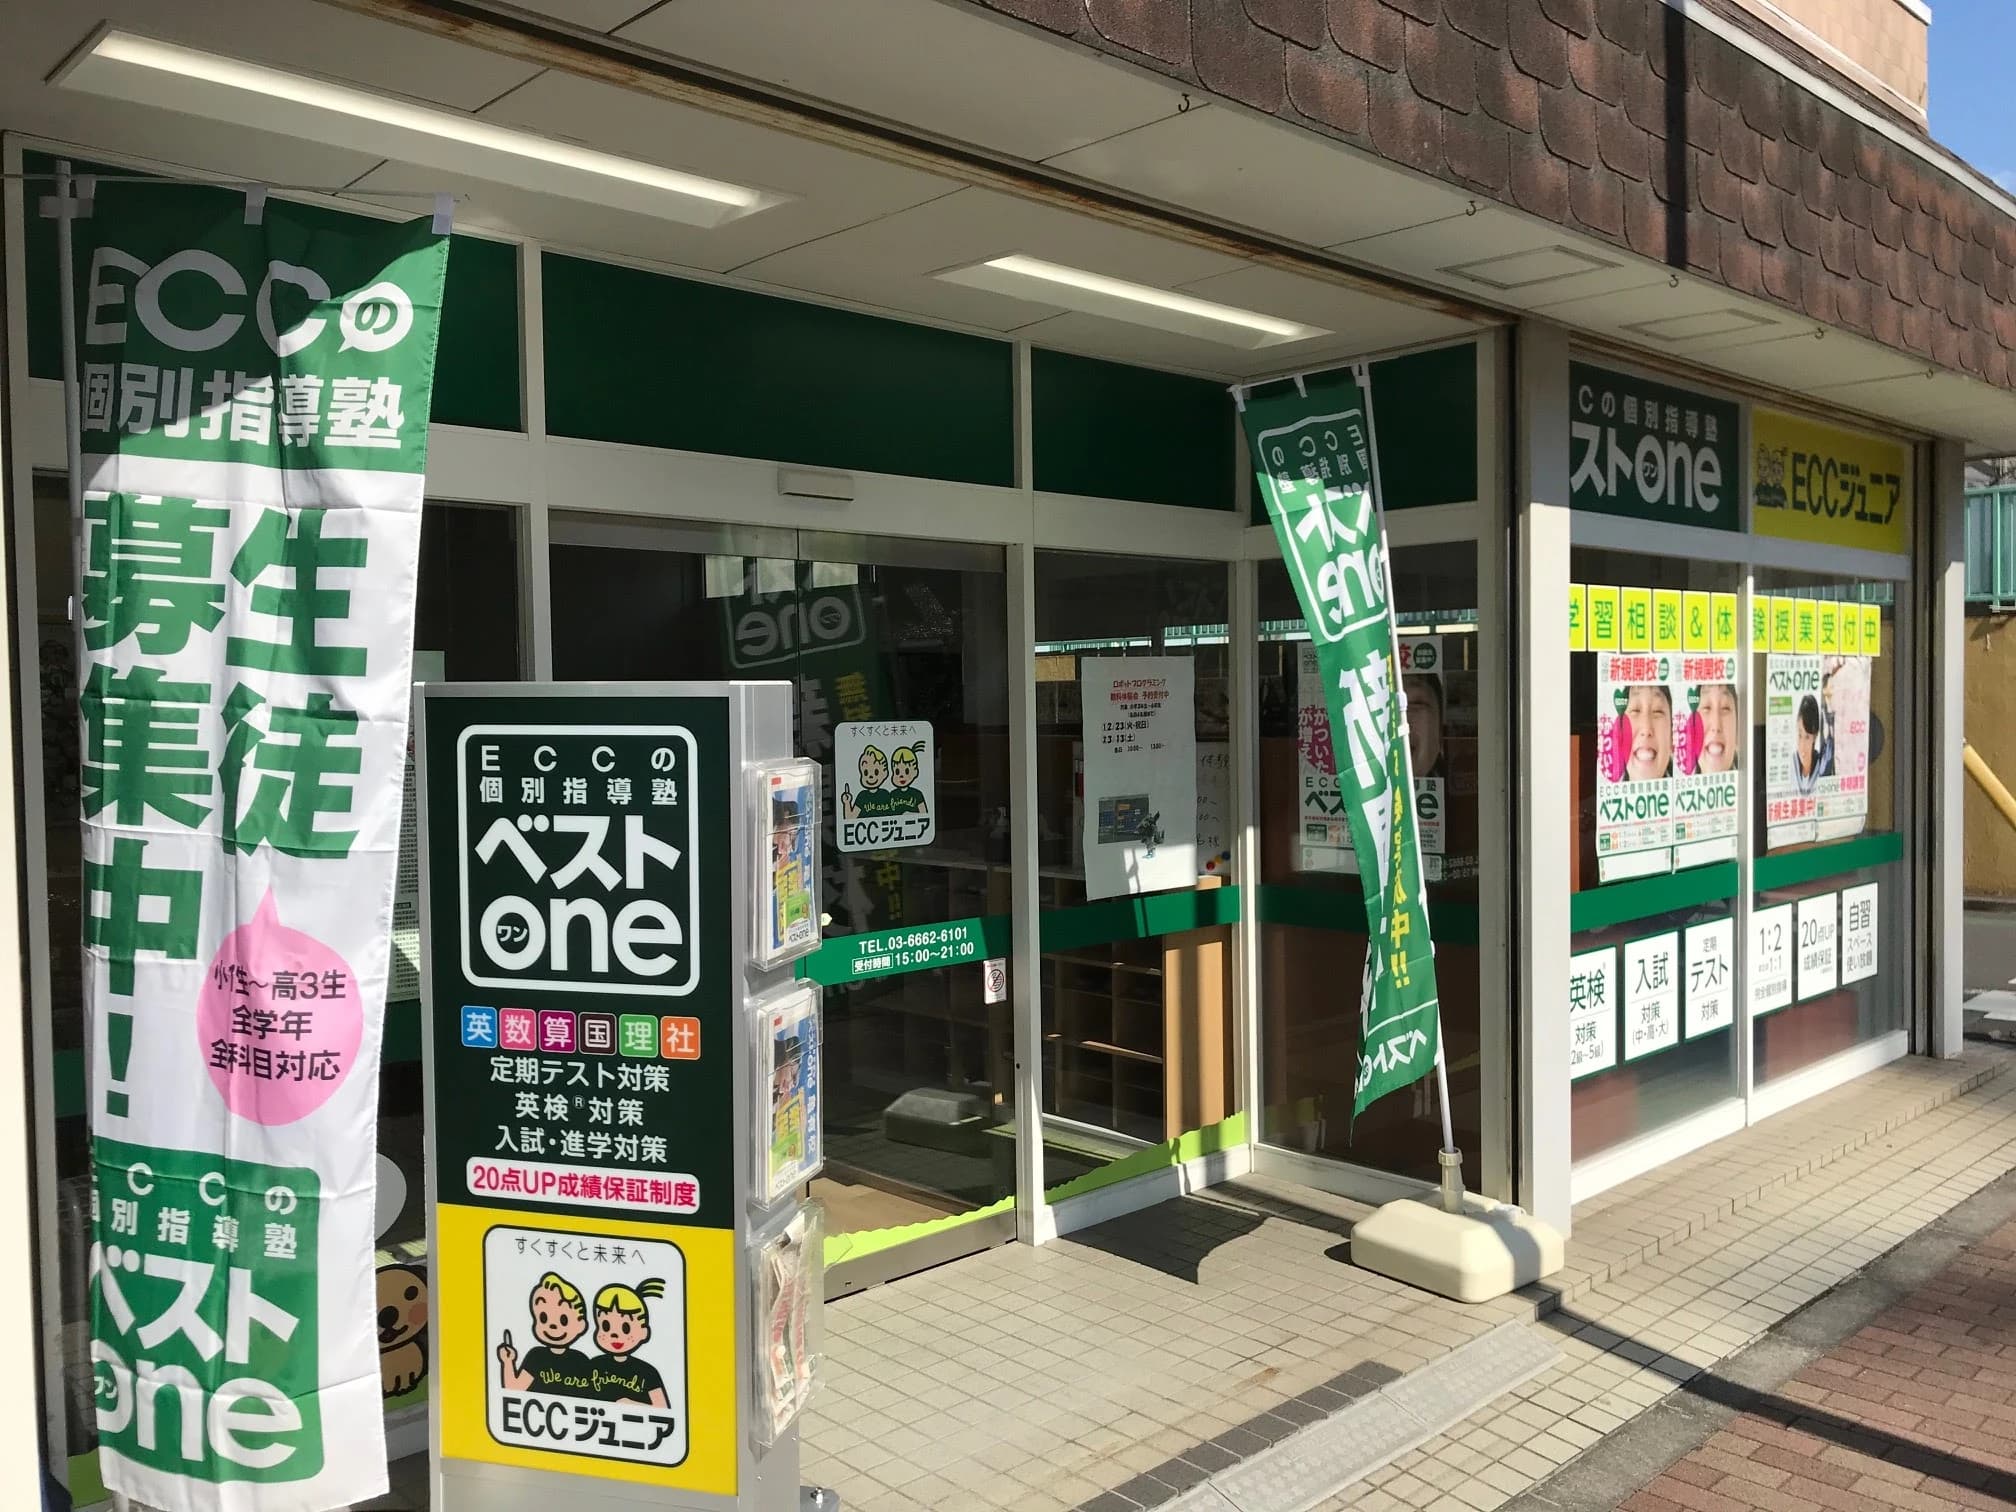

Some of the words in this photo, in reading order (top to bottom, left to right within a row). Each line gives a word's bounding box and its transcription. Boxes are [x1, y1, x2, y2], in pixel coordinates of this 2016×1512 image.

[82, 361, 405, 449] 個別指導塾
[1791, 451, 1900, 525] ECCジュニア
[218, 507, 368, 860] 生徒
[849, 725, 918, 737] すくすくと未来へ
[480, 745, 676, 772] ECCの
[479, 776, 679, 807] 個別指導塾
[844, 817, 931, 846] ECCジュニア
[474, 814, 682, 892] ベスト
[479, 895, 683, 977] one
[497, 924, 528, 944] ワン
[858, 926, 968, 955] TEL.03-6662-6101
[1634, 951, 1669, 994] 入試
[1690, 953, 1729, 994] テスト
[231, 1004, 313, 1041] 全学年
[1640, 1000, 1661, 1025] 対策
[1700, 999, 1719, 1022] 対策
[466, 1008, 494, 1043] 英
[504, 1011, 532, 1048] 数
[543, 1013, 573, 1050] 算
[583, 1017, 612, 1051] 国
[624, 1019, 654, 1054] 理
[665, 1021, 697, 1056] 社
[1575, 1020, 1597, 1047] 対策
[209, 1038, 341, 1082] 全科目対応
[489, 1055, 671, 1093] 定期テスト対策
[494, 1124, 669, 1165] 入試・進学対策
[471, 1163, 698, 1210] 20点UP成績保証制度
[513, 1235, 647, 1266] すくすくと未来へ
[539, 1370, 564, 1386] We
[564, 1374, 589, 1388] are
[591, 1367, 646, 1395] friends!
[502, 1396, 676, 1451] ECCジュニア
